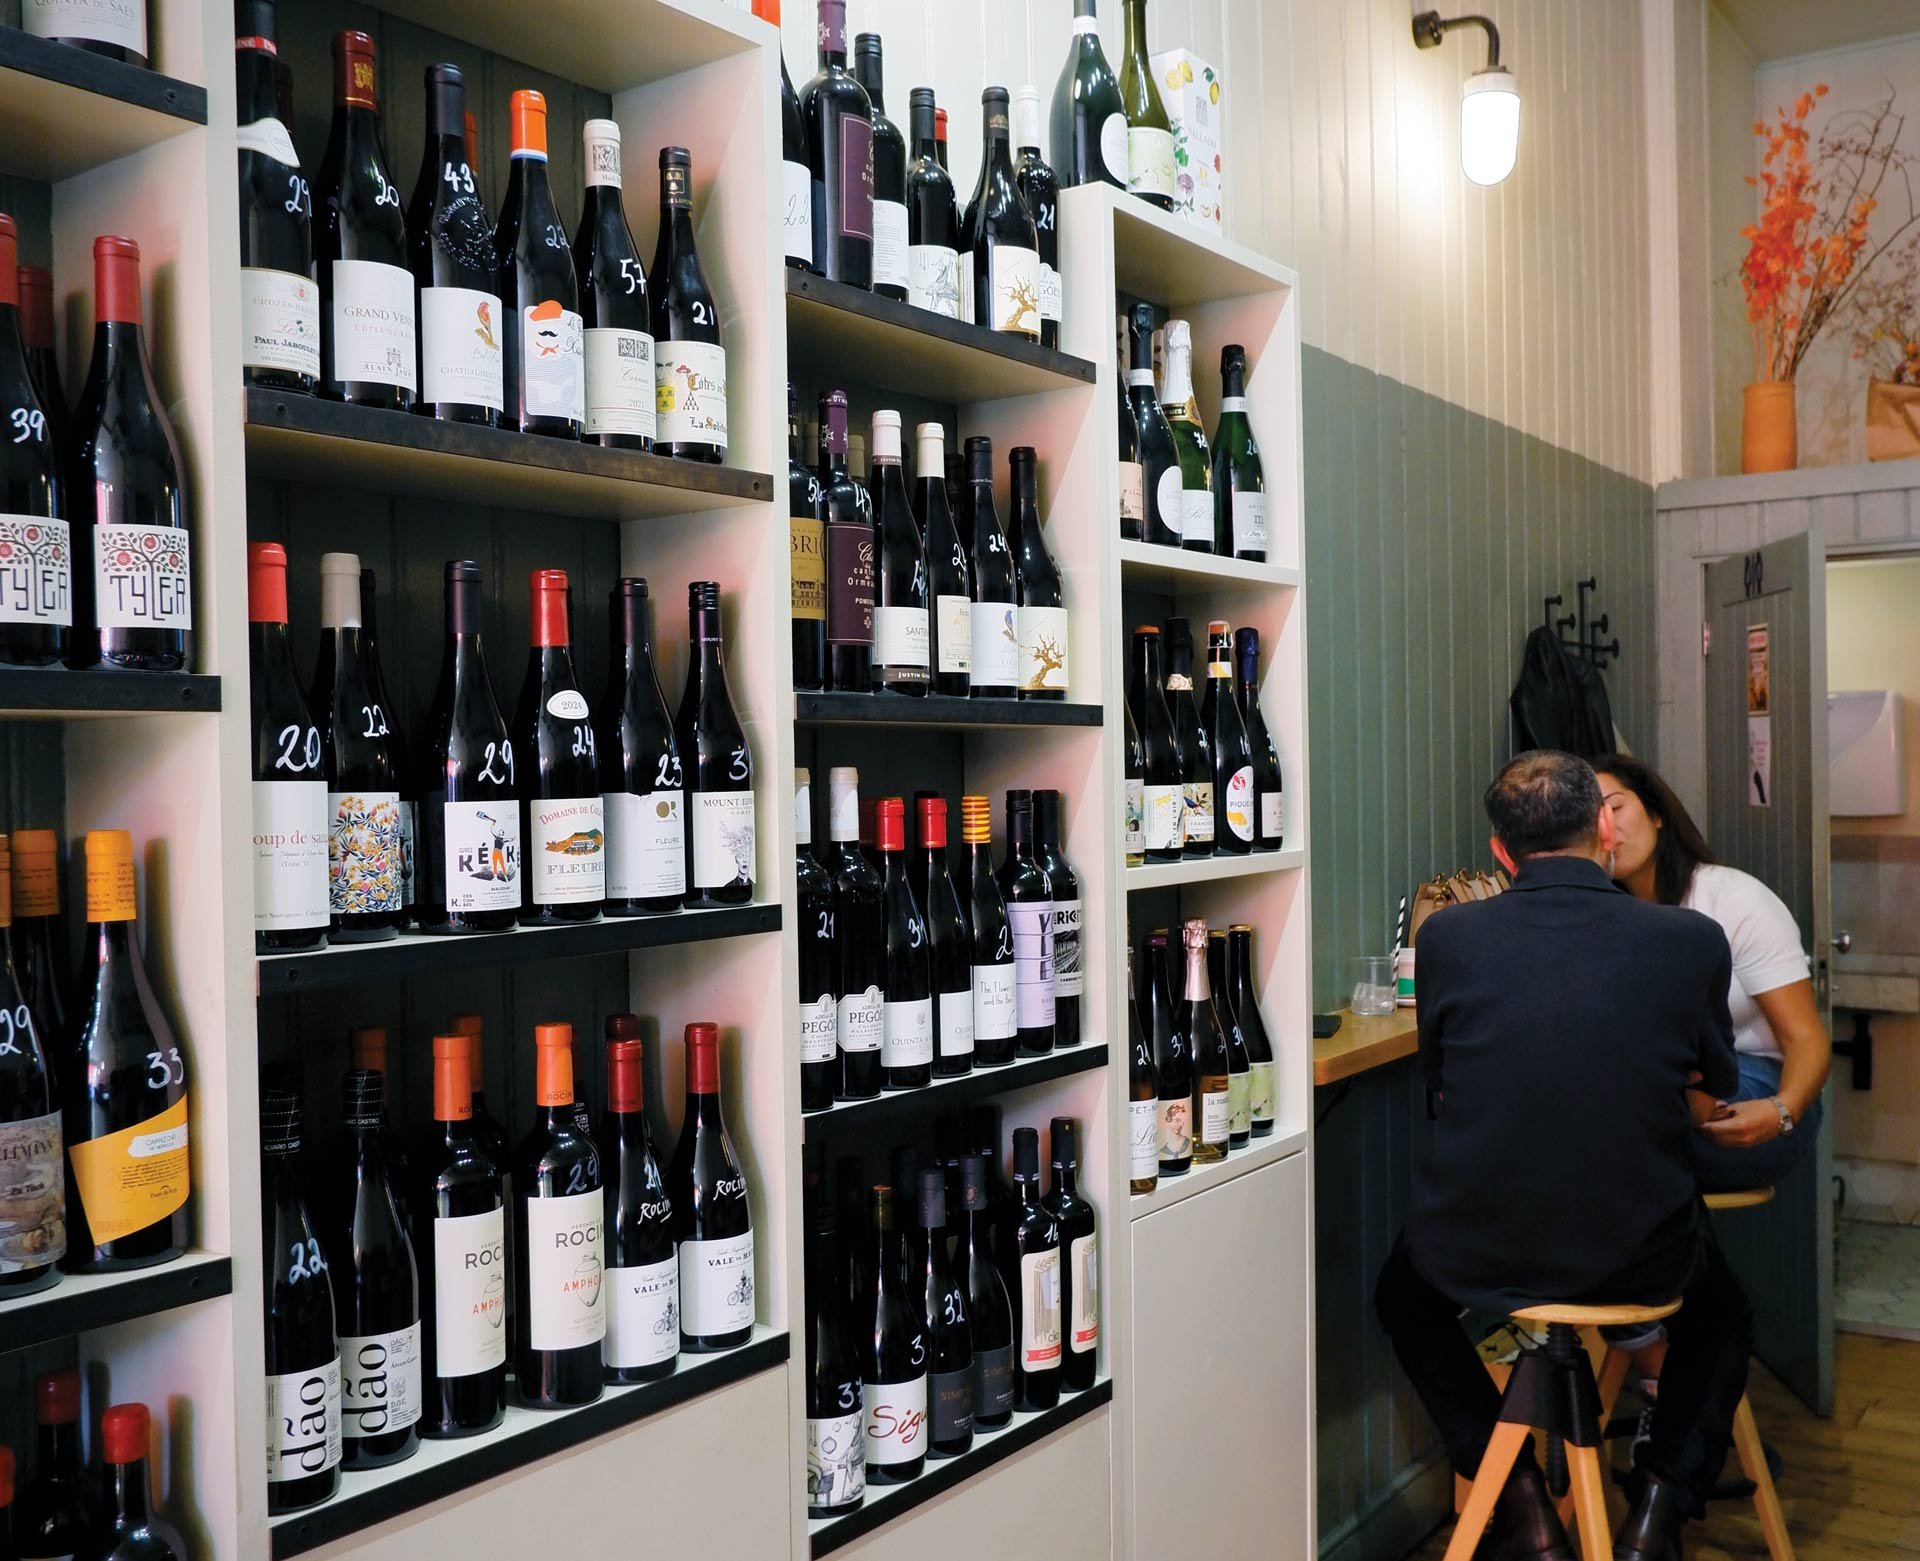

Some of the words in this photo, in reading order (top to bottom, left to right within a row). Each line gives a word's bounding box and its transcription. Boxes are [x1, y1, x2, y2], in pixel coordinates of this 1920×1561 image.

[374, 175, 400, 207] 20
[443, 162, 475, 194] 43
[285, 174, 313, 217] 29
[1036, 203, 1055, 230] 21
[620, 258, 647, 294] 57
[344, 305, 390, 321] GRAND
[691, 301, 714, 325] 21
[254, 335, 280, 346] PAUL
[363, 363, 394, 374] ALAIN
[628, 399, 645, 409] 2021
[10, 407, 46, 444] 39
[989, 533, 1007, 552] 24
[898, 671, 921, 679] JUSTIN
[362, 704, 390, 738] 22
[275, 724, 321, 772] 20
[571, 724, 595, 758] 24
[477, 740, 514, 786] 29
[655, 753, 683, 788] 23
[539, 805, 578, 825] DOMAINE
[703, 798, 740, 807] MOUNT
[290, 829, 308, 844] de
[816, 911, 835, 940] 21
[0, 1004, 39, 1056] 29
[892, 1037, 923, 1046] QUINTA
[146, 1048, 183, 1089] 33
[565, 1156, 600, 1196] 29
[288, 1237, 328, 1285] 22
[708, 1257, 734, 1267] VALE
[633, 1283, 660, 1295] VALE
[341, 1342, 388, 1434] dão
[280, 1375, 327, 1473] dão
